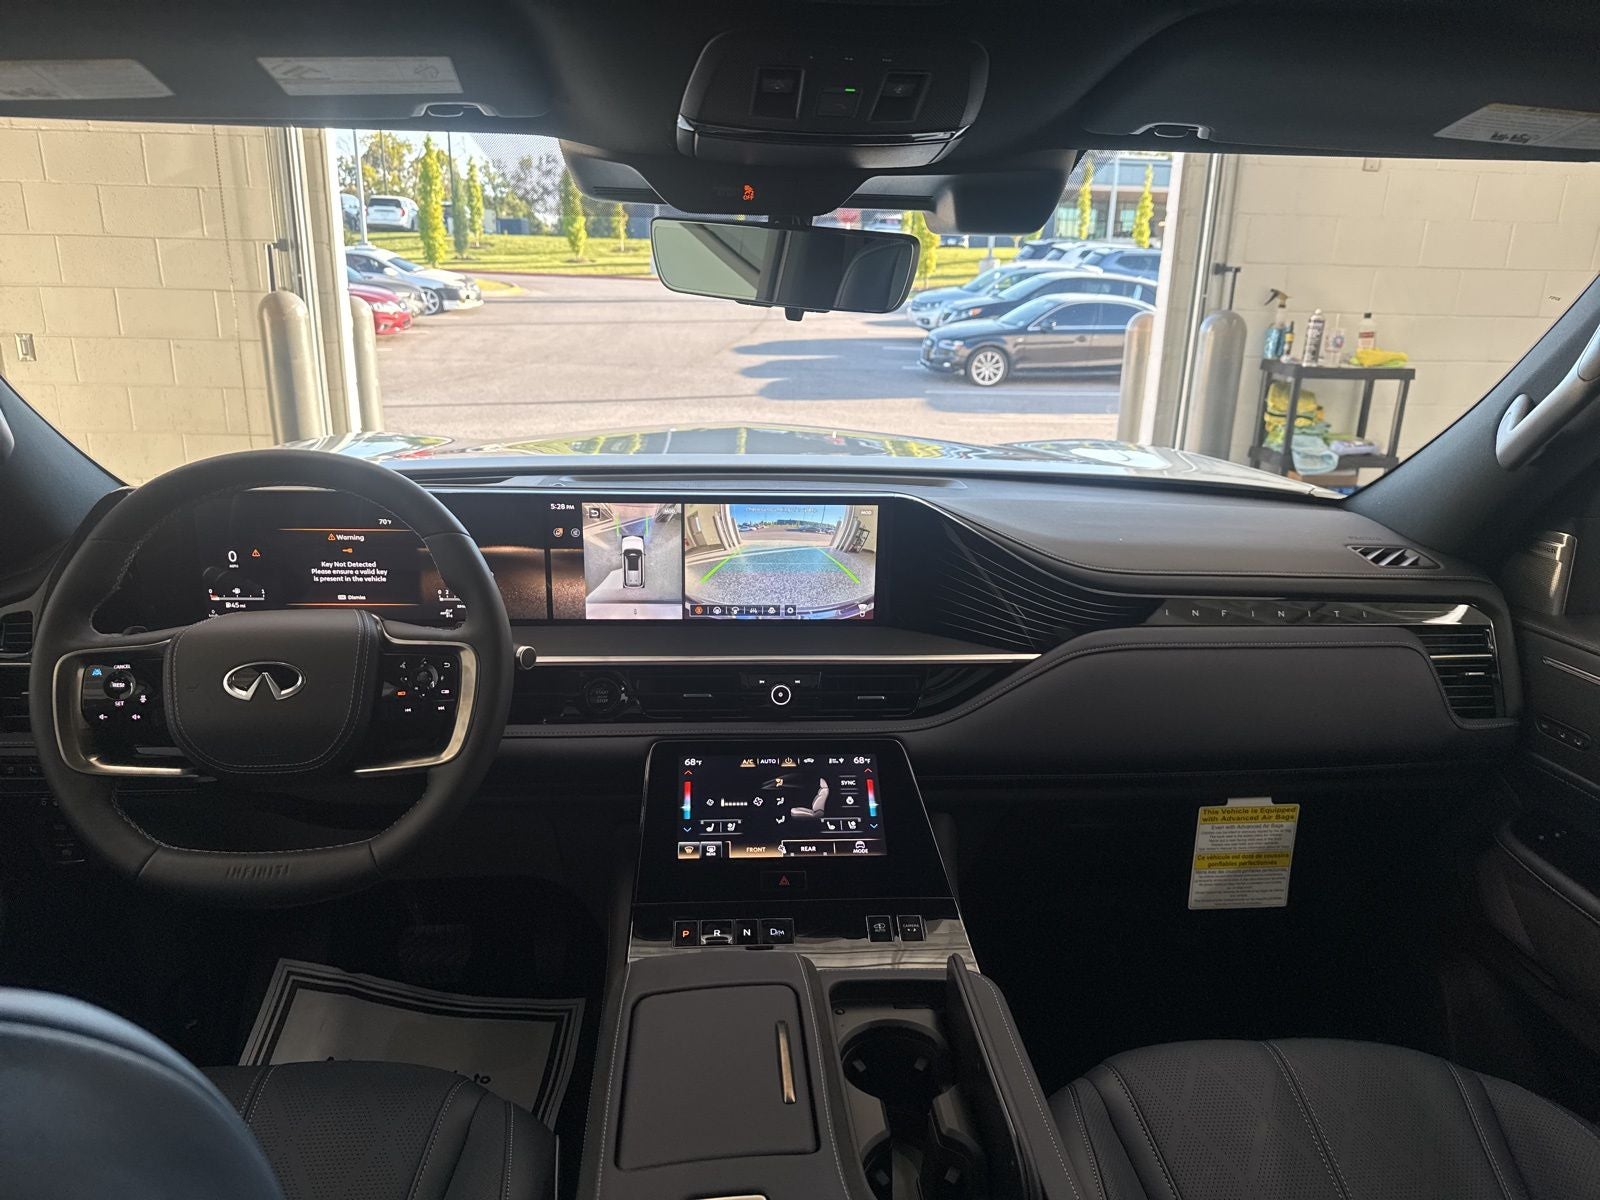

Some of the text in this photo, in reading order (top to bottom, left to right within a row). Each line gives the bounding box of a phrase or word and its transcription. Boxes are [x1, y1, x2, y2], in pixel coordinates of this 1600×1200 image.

[335, 534, 365, 542] Warning
[227, 550, 237, 562] 0
[376, 568, 388, 576] key
[1164, 608, 1369, 618] INFINITI
[684, 758, 703, 766] 68°F
[853, 756, 871, 764] 68°F
[1221, 807, 1249, 815] Vehicle
[1260, 807, 1296, 815] Equipped
[682, 930, 690, 938] P
[713, 929, 721, 937] R
[743, 928, 751, 937] N
